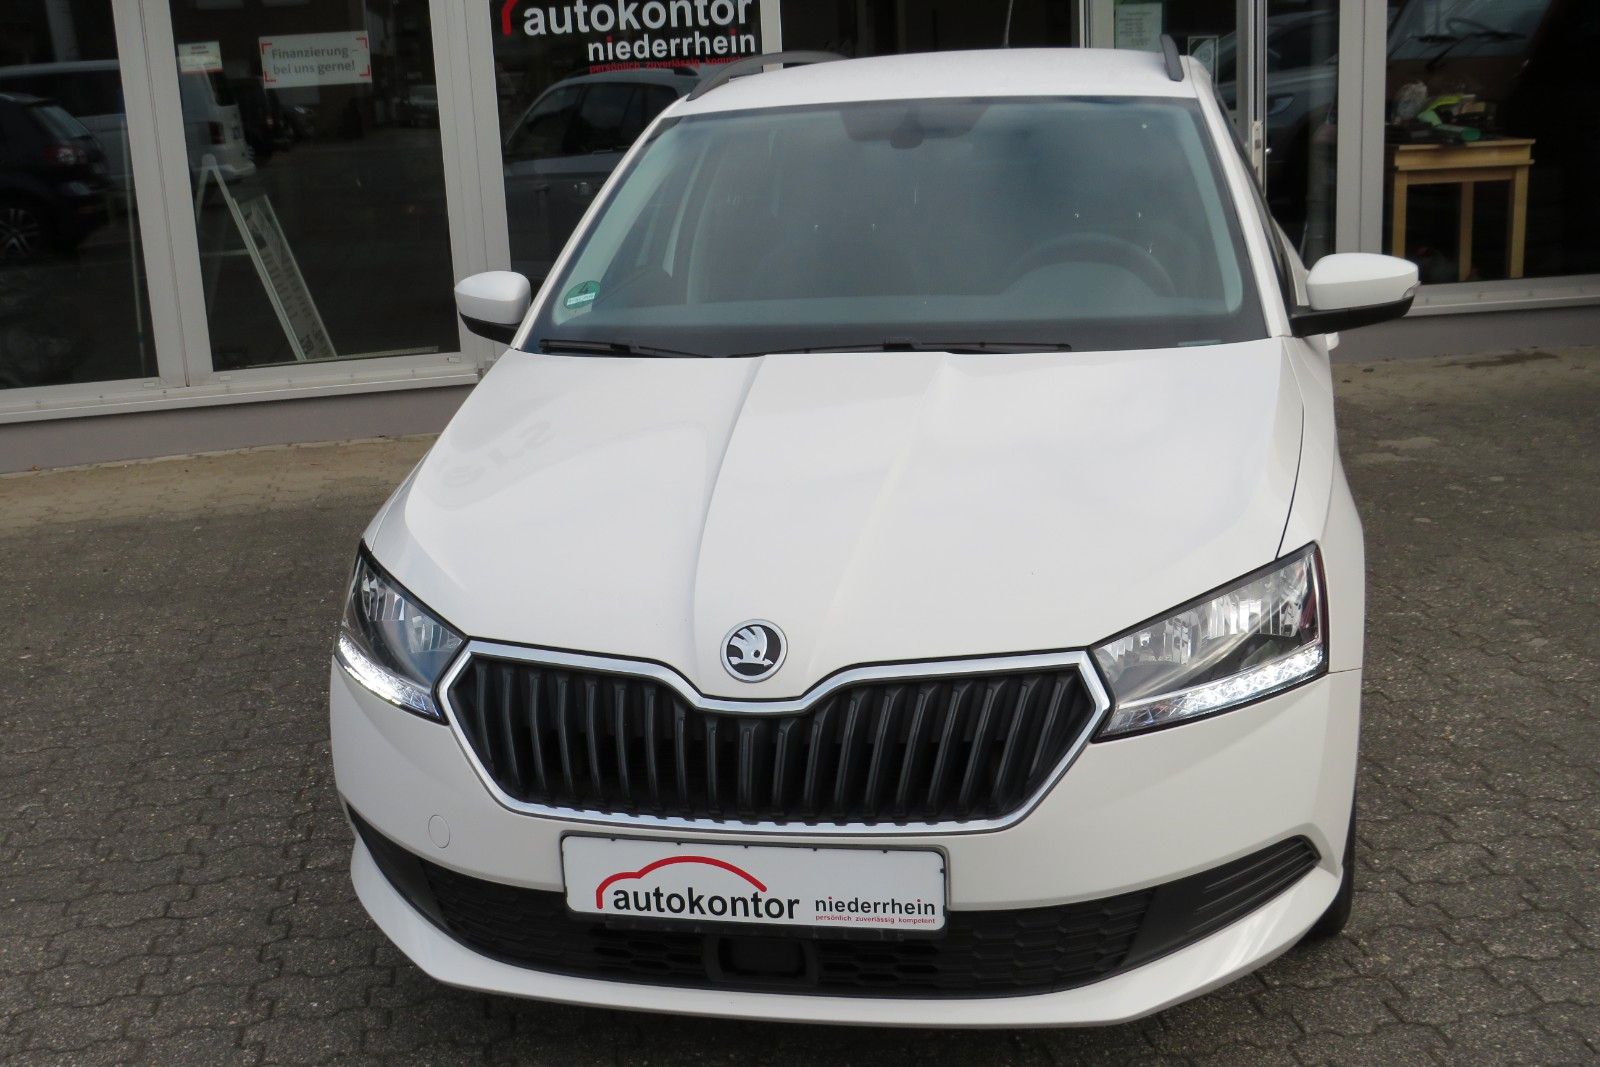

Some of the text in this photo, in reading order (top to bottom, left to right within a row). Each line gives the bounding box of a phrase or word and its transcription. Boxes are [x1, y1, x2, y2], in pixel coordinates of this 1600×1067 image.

[523, 0, 752, 36] autokontor
[271, 45, 349, 60] Finanzierung
[588, 28, 756, 62] niederrhein
[273, 60, 356, 75] bei uns gerne!
[613, 886, 936, 919] autokontor niederrhein
[815, 914, 852, 922] persönlich
[898, 917, 936, 925] kompetent
